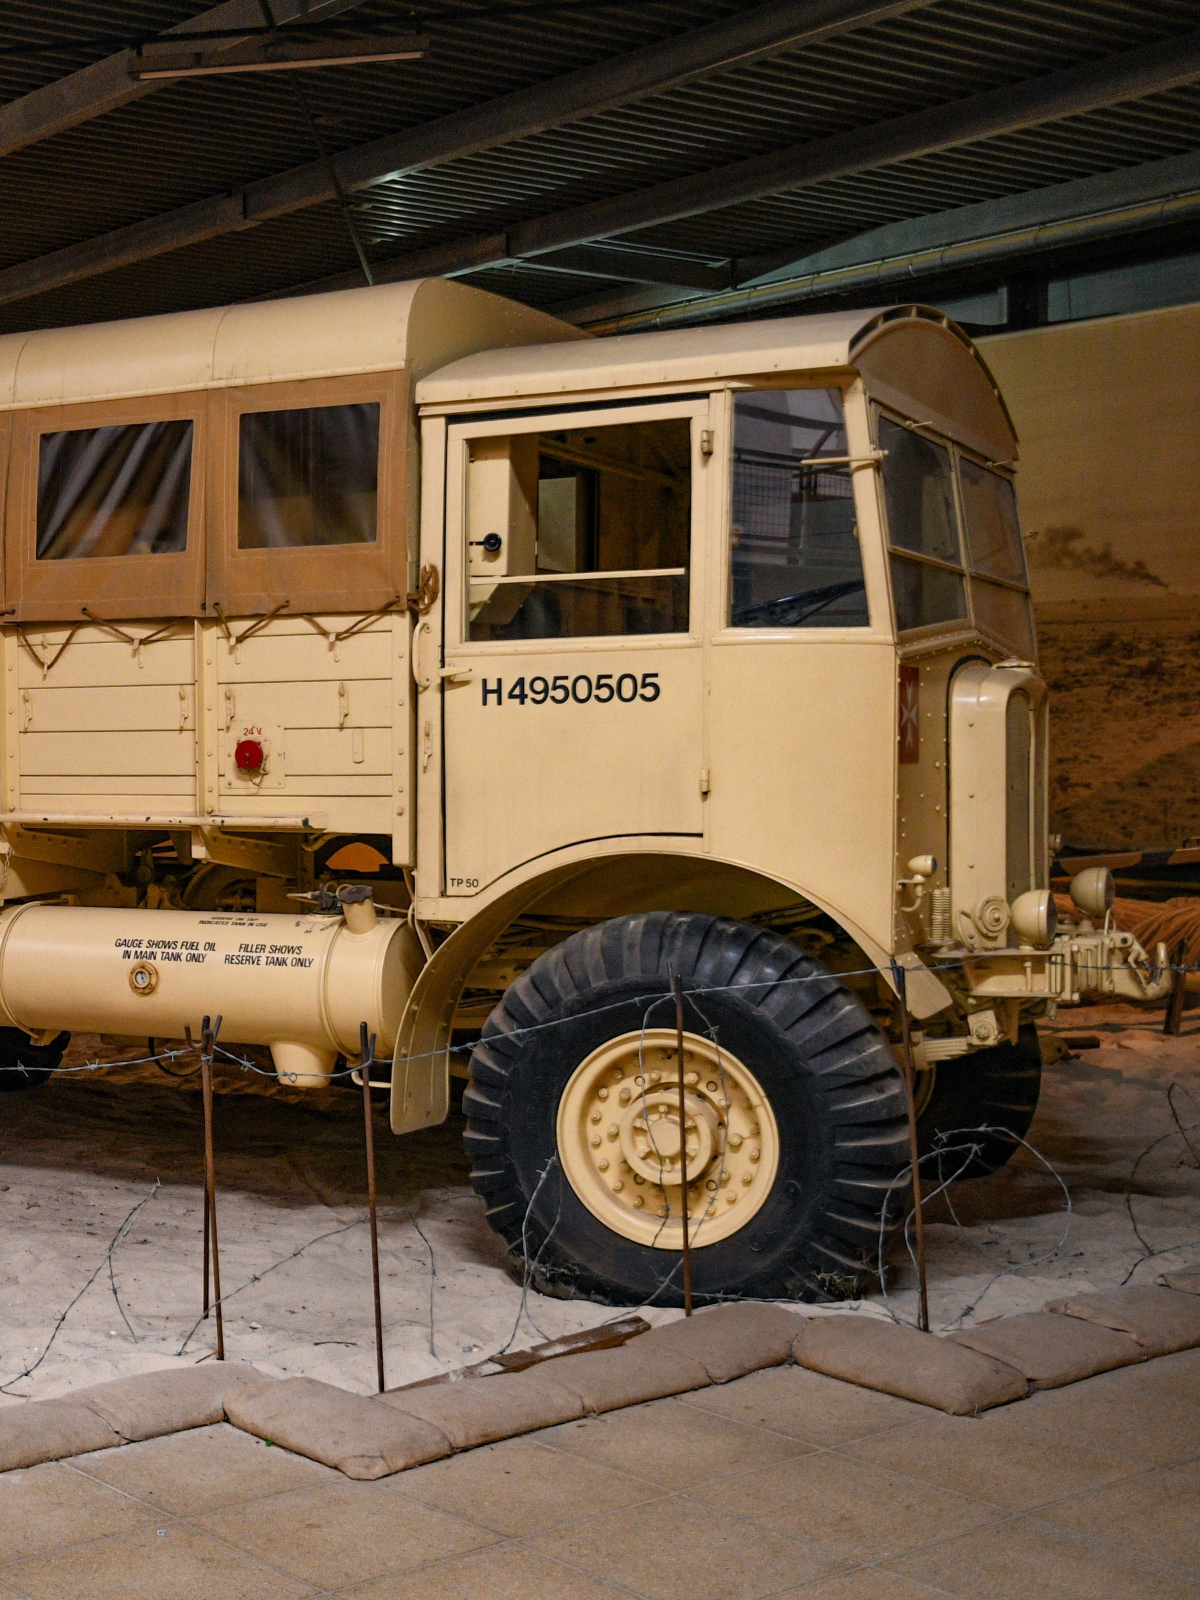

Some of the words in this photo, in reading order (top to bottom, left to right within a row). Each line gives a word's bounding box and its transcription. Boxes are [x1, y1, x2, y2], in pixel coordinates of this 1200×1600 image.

[481, 672, 661, 706] H4950505
[243, 727, 254, 736] 24
[450, 877, 464, 887] TP
[465, 878, 479, 888] 50
[115, 938, 144, 948] GAUGE
[146, 939, 178, 950] SHOWS
[180, 940, 200, 950] FUEL
[203, 941, 217, 951] OIL
[238, 943, 267, 954] FILLER
[268, 944, 303, 955] SHOWS
[122, 950, 131, 959] IN
[133, 950, 157, 960] MAIN
[160, 951, 183, 962] TANK
[185, 952, 207, 963] ONLY
[224, 954, 262, 966] RESERVE
[265, 956, 289, 967] TANK
[290, 957, 314, 968] ONLY
